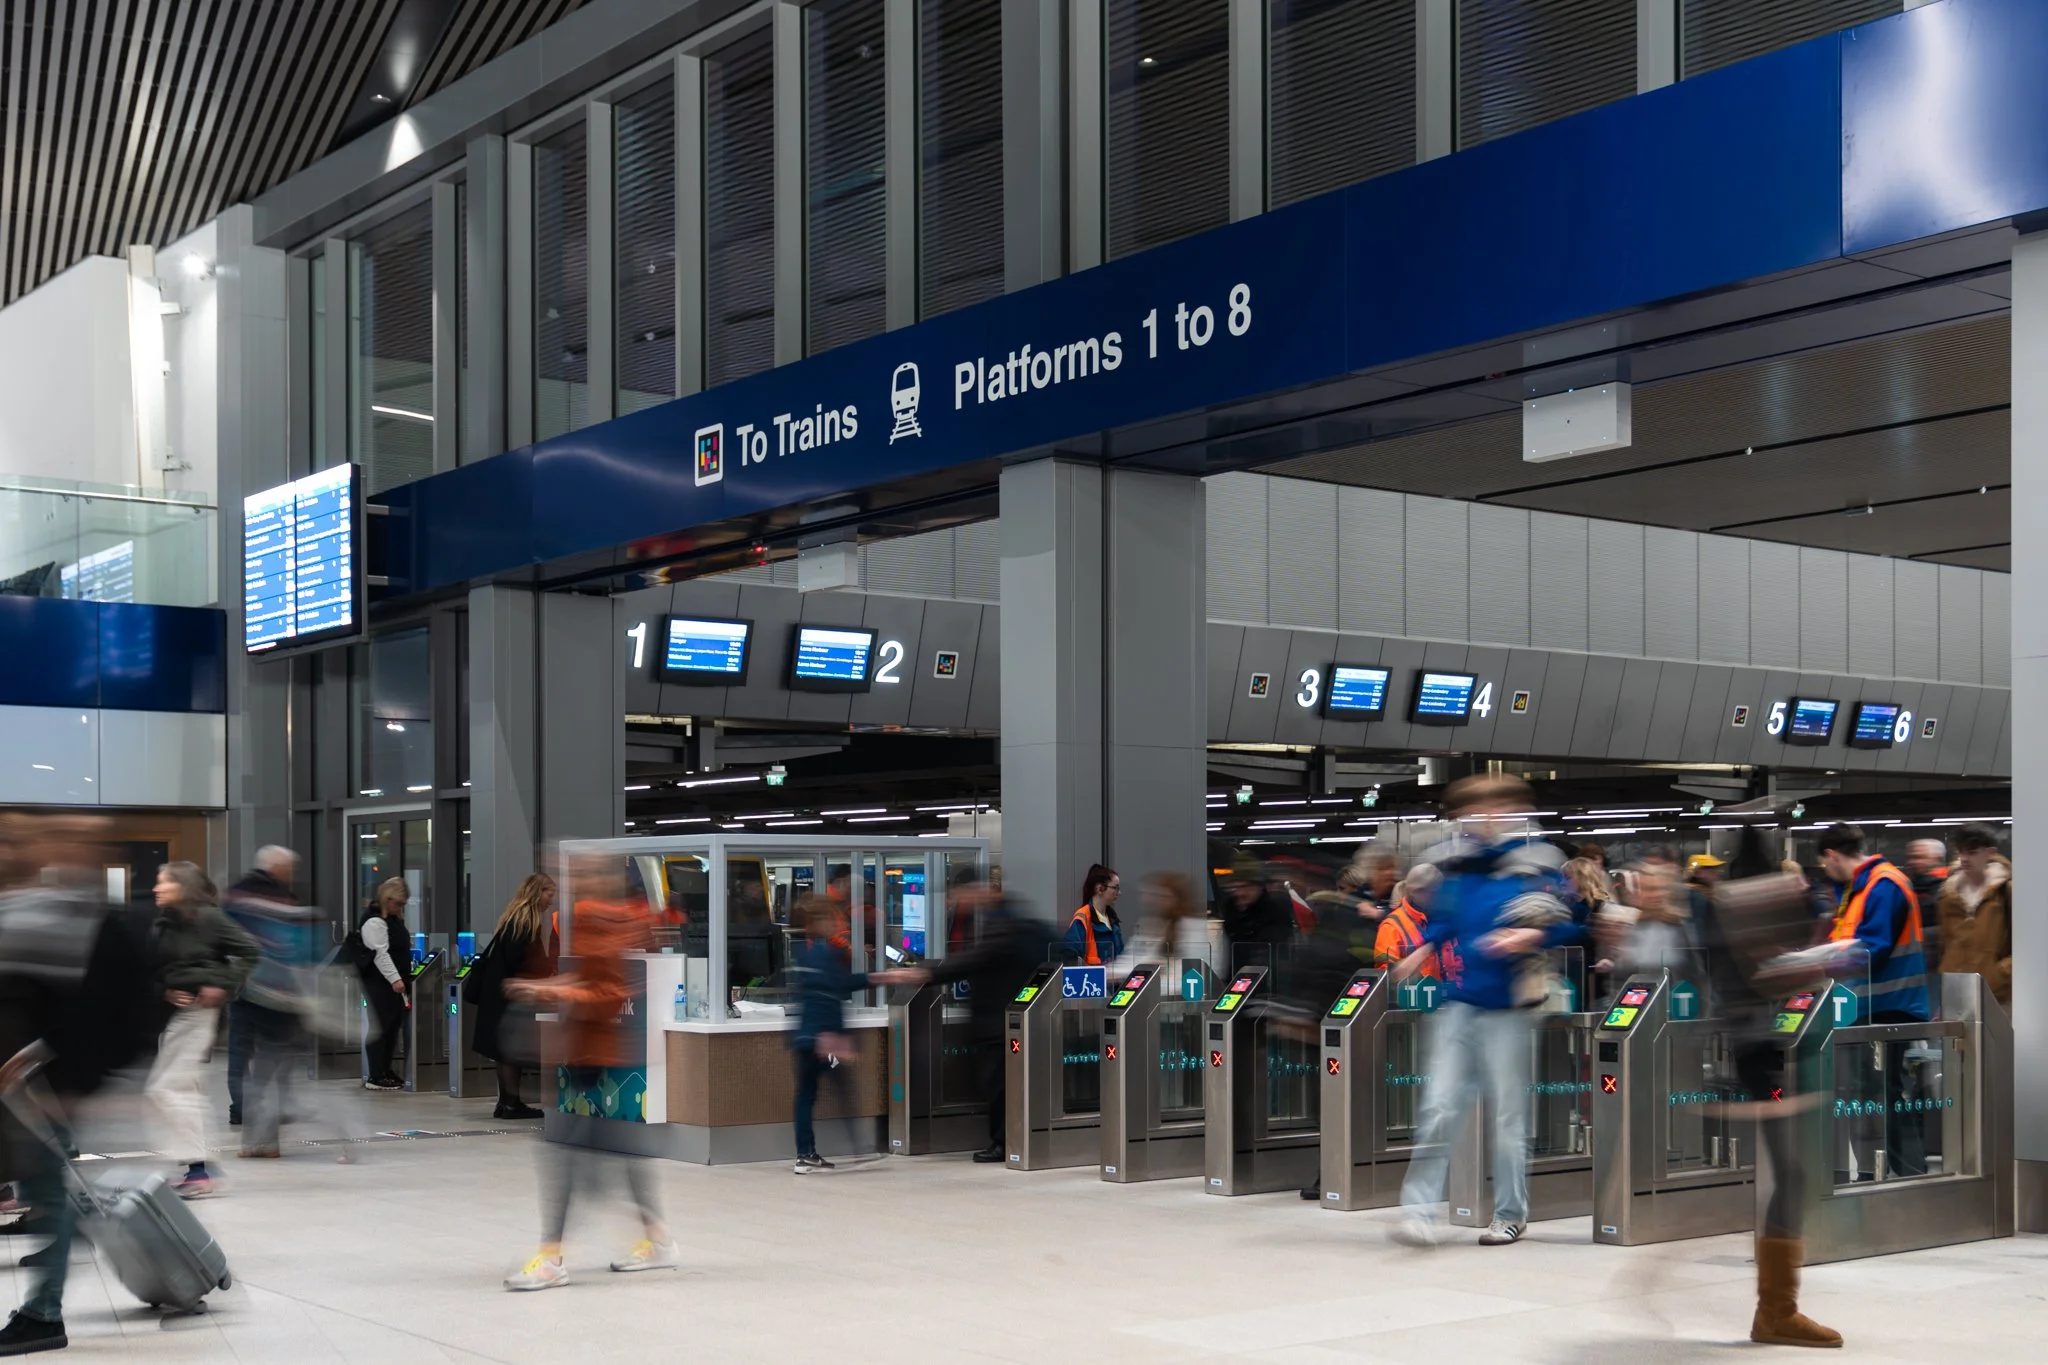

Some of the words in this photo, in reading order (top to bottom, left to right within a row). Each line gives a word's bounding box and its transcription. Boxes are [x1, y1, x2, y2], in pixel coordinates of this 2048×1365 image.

[954, 331, 1123, 411] Platforms
[1142, 308, 1158, 360] 1
[1175, 302, 1214, 351] to
[1228, 283, 1252, 338] 8
[736, 422, 768, 467] To
[772, 404, 859, 457] Trains
[626, 622, 648, 669] 1
[874, 639, 905, 685] 2
[1297, 668, 1320, 709] 3
[1472, 682, 1494, 719] 4
[1767, 701, 1787, 735] 5
[1894, 710, 1912, 743] 6
